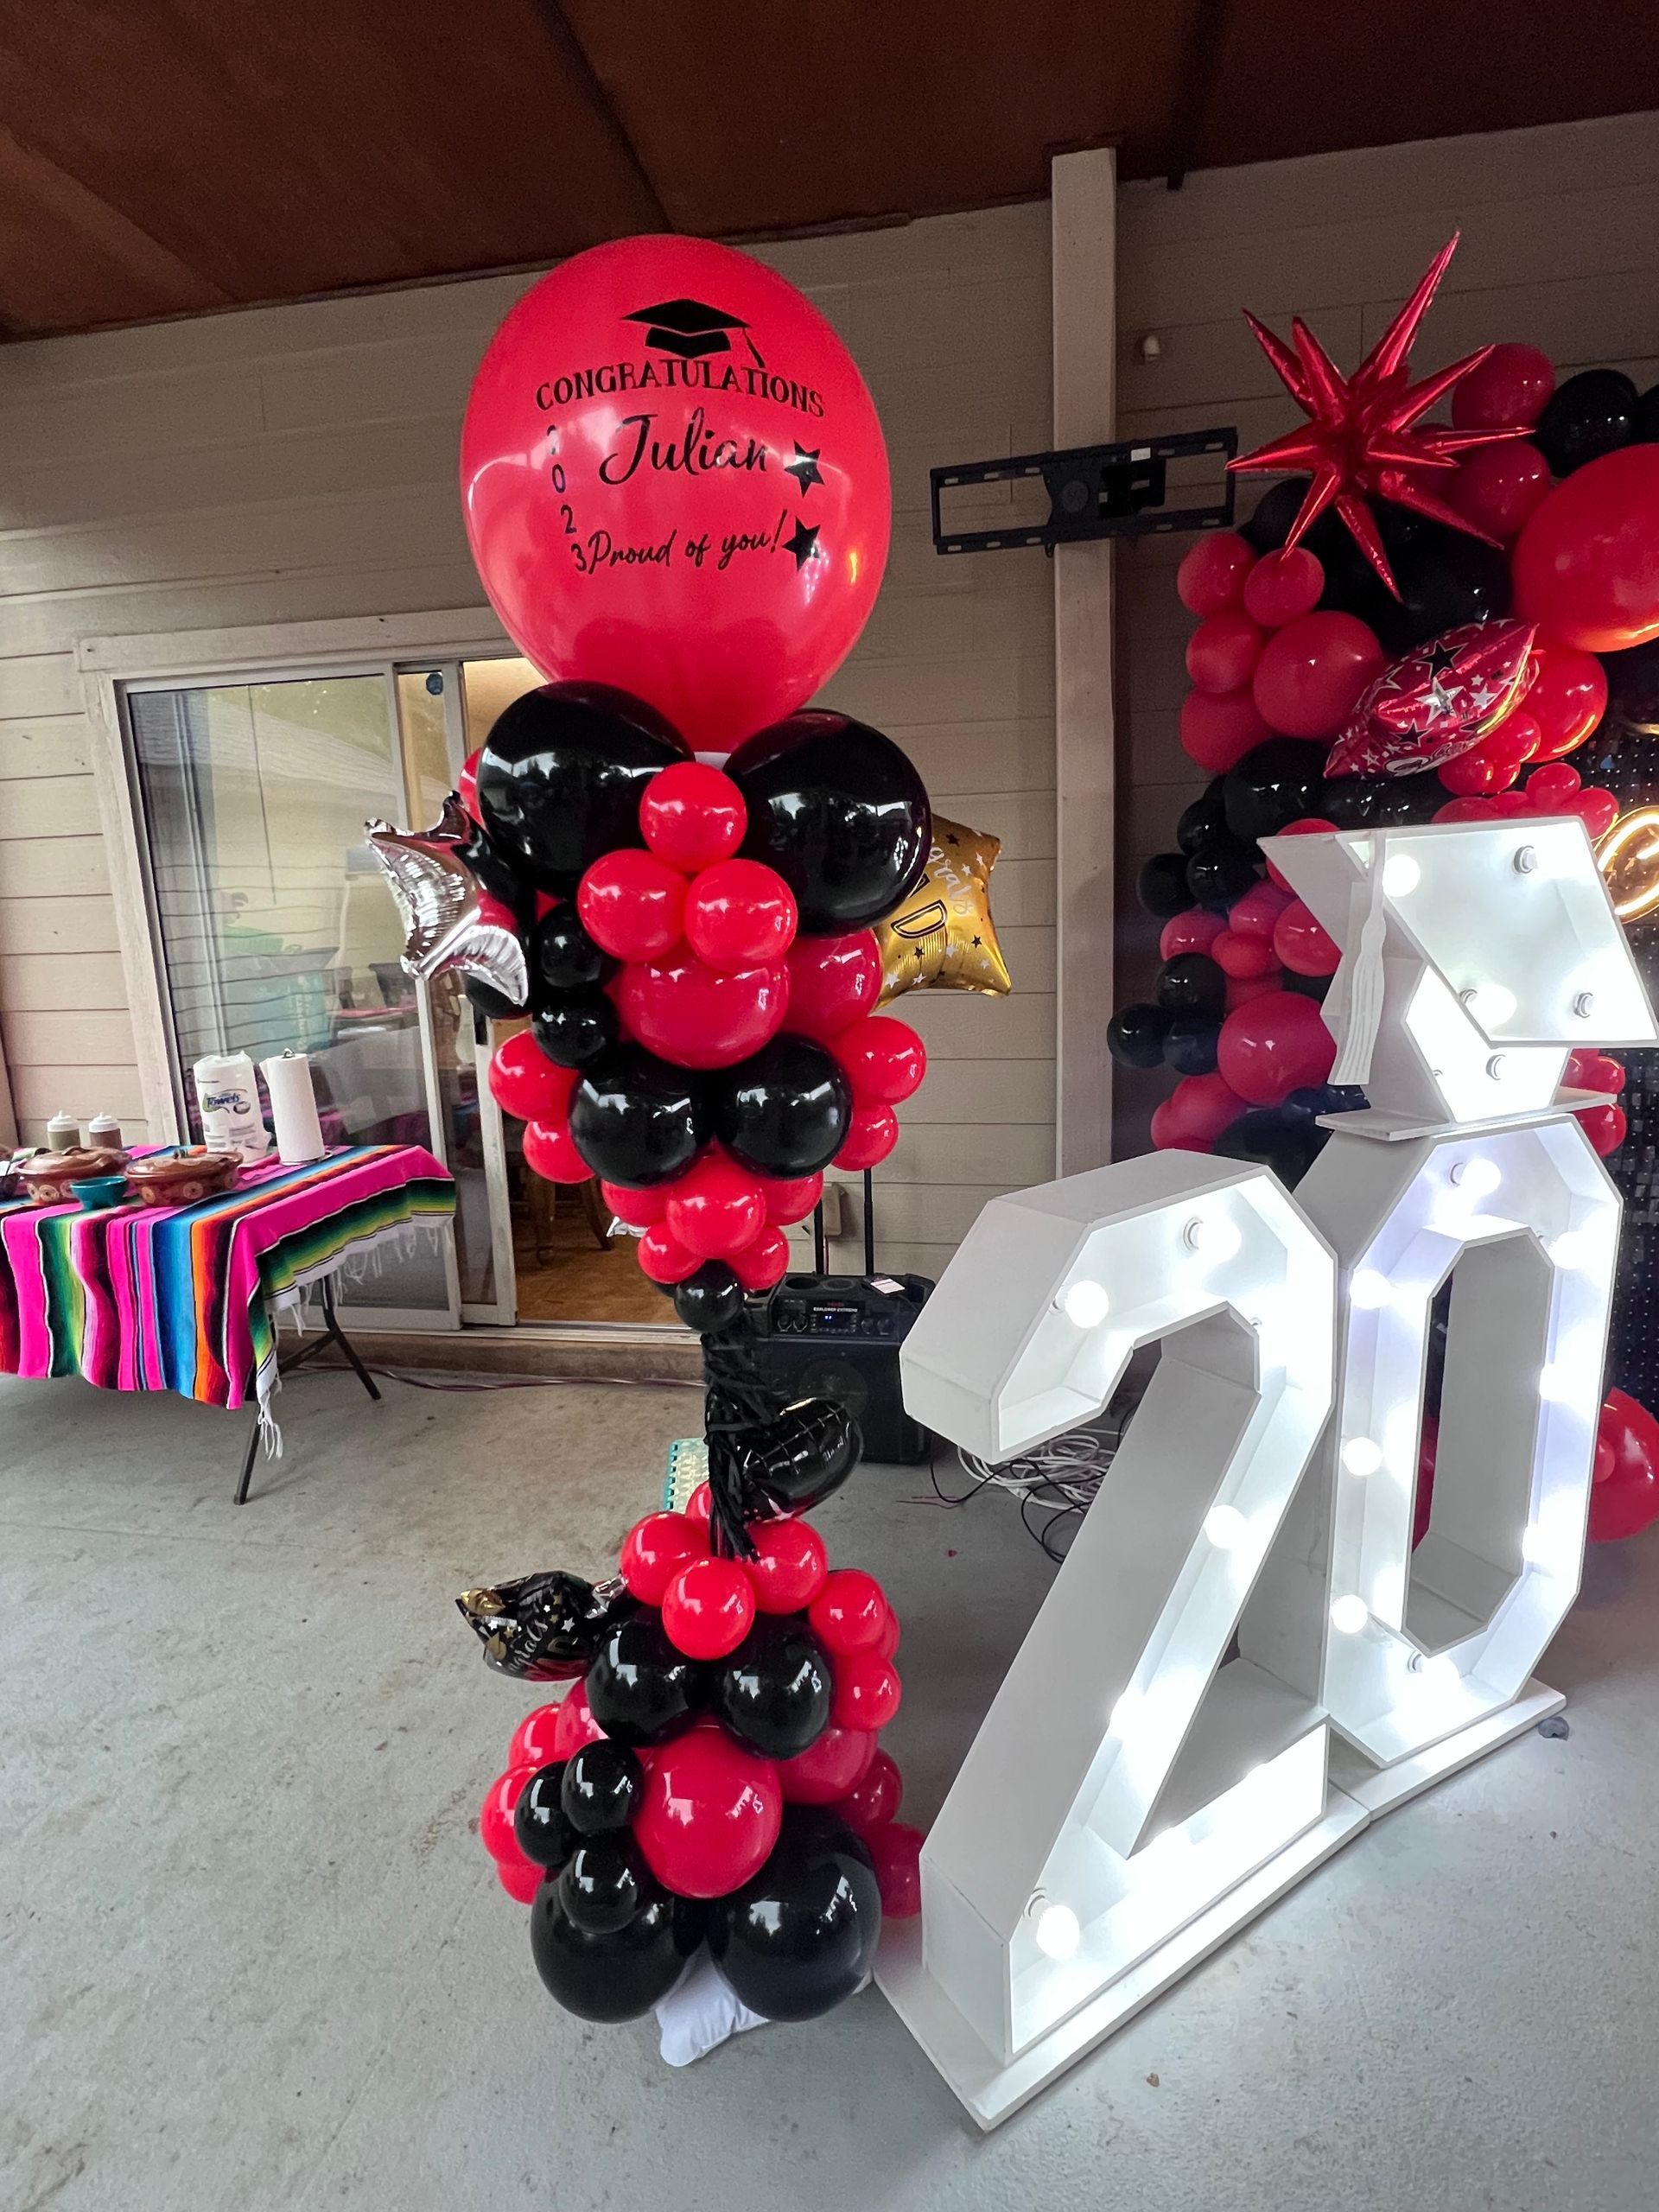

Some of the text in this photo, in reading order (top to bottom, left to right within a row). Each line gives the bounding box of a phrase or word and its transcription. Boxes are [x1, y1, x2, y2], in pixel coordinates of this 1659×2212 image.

[536, 359, 824, 417] CONGRATULATIONS
[599, 407, 767, 485] Julian
[588, 508, 788, 575] Proud of you!
[207, 1093, 240, 1108] Towels
